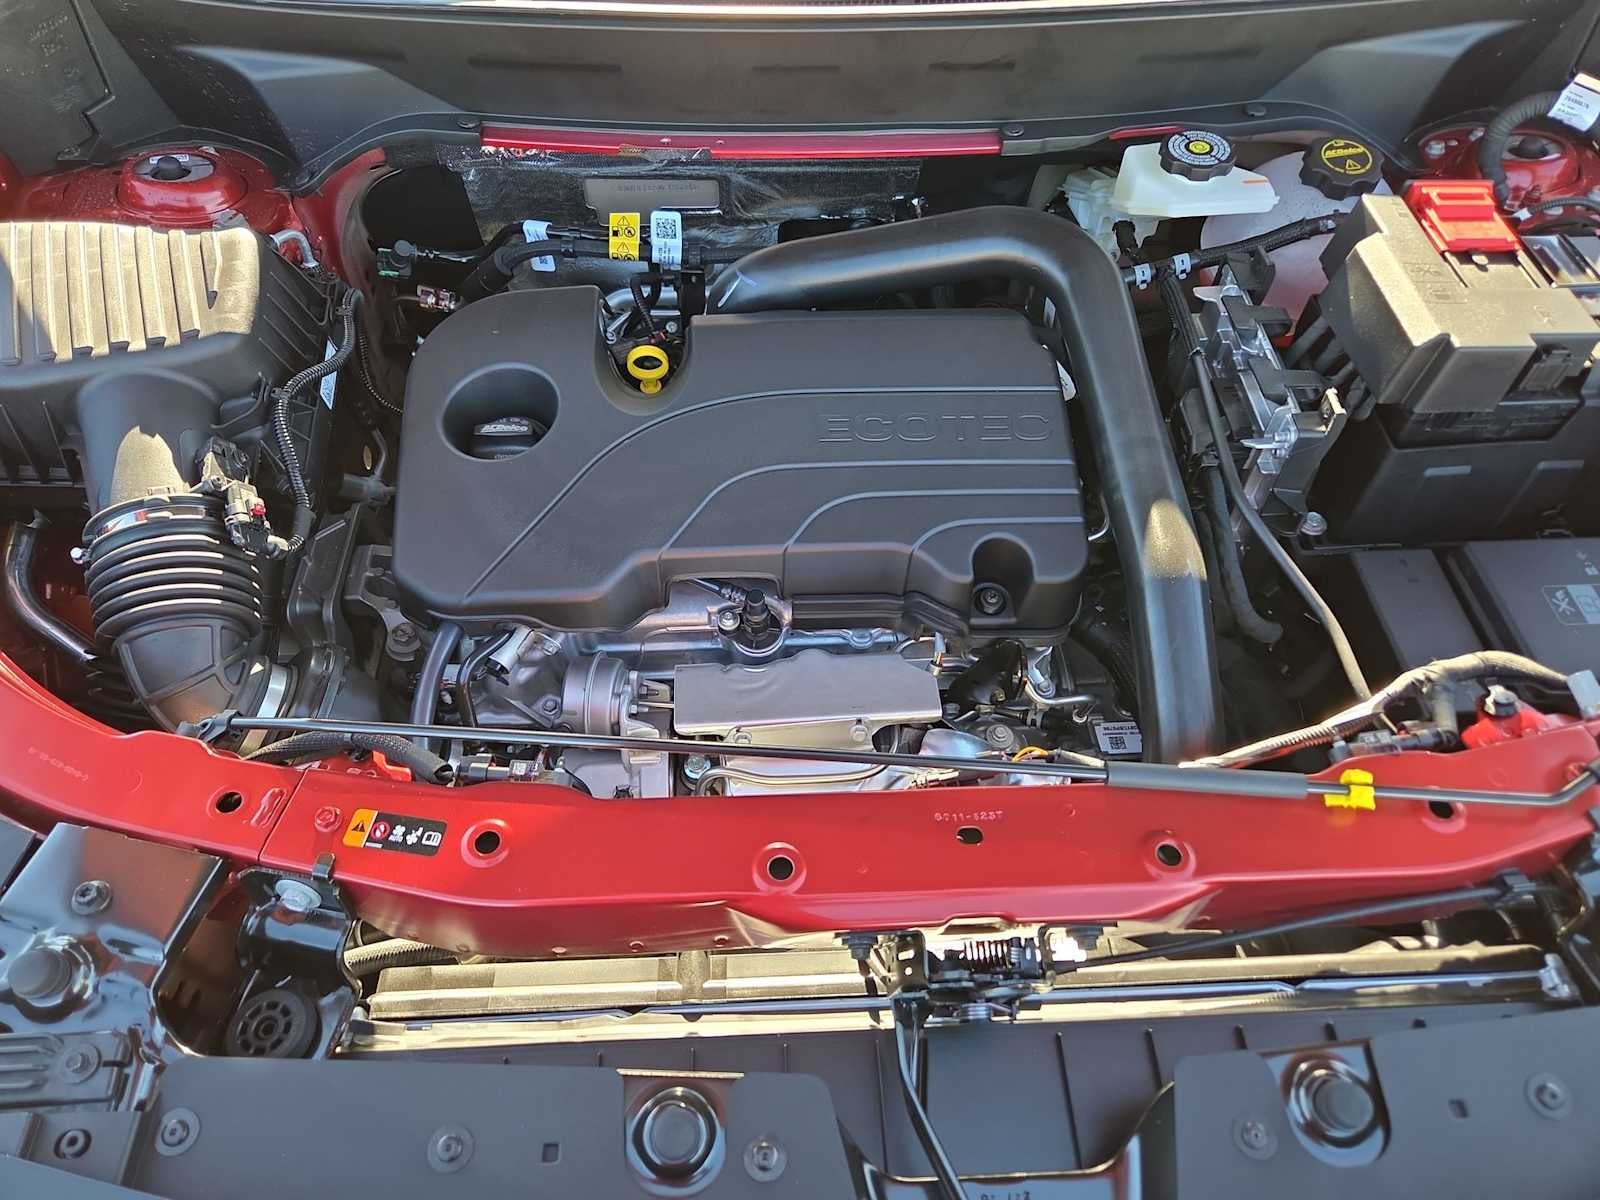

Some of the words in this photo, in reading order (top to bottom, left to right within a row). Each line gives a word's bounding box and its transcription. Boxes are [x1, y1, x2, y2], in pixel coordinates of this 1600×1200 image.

[1324, 147, 1365, 158] ACDelco
[480, 424, 528, 433] ACDelco
[816, 413, 1050, 442] ECOTEC
